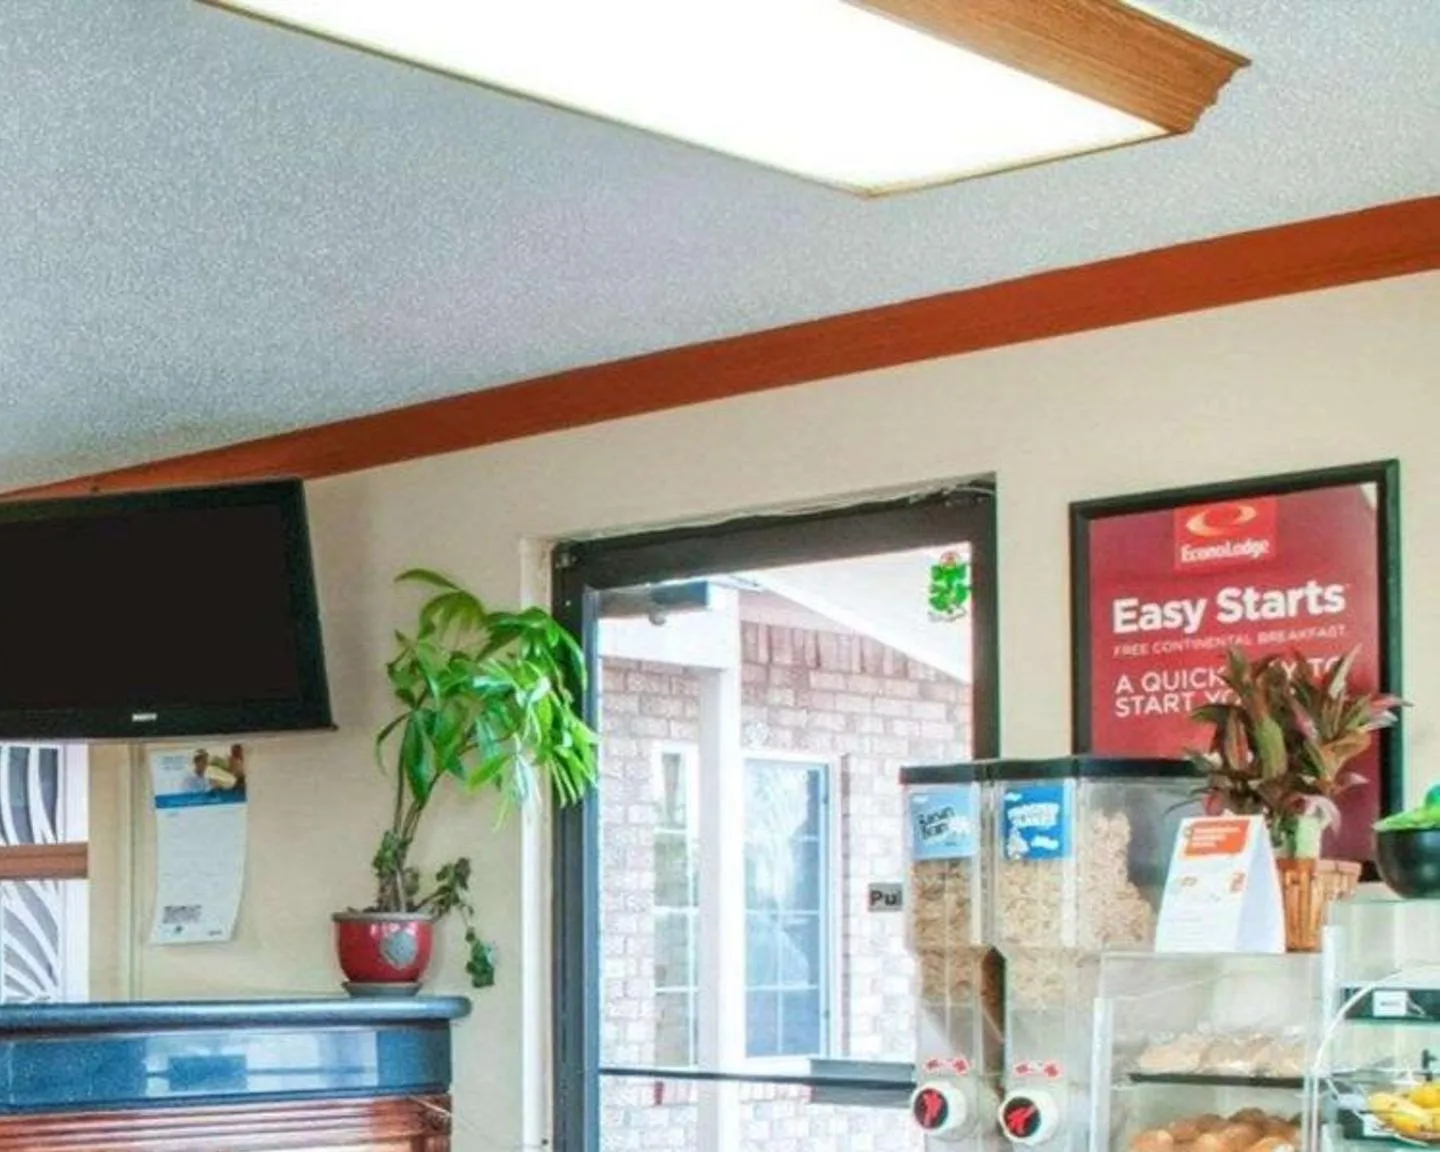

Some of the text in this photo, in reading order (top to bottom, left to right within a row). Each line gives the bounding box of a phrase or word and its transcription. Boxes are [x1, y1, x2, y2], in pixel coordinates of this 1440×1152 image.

[1181, 539, 1269, 561] EconoLodge
[1112, 579, 1347, 635] Easy Starts
[1113, 624, 1347, 657] FREE CONTINENTAL BREAKFAST
[1115, 674, 1135, 694] A
[1140, 664, 1228, 693] QUICK
[1115, 690, 1197, 718] START
